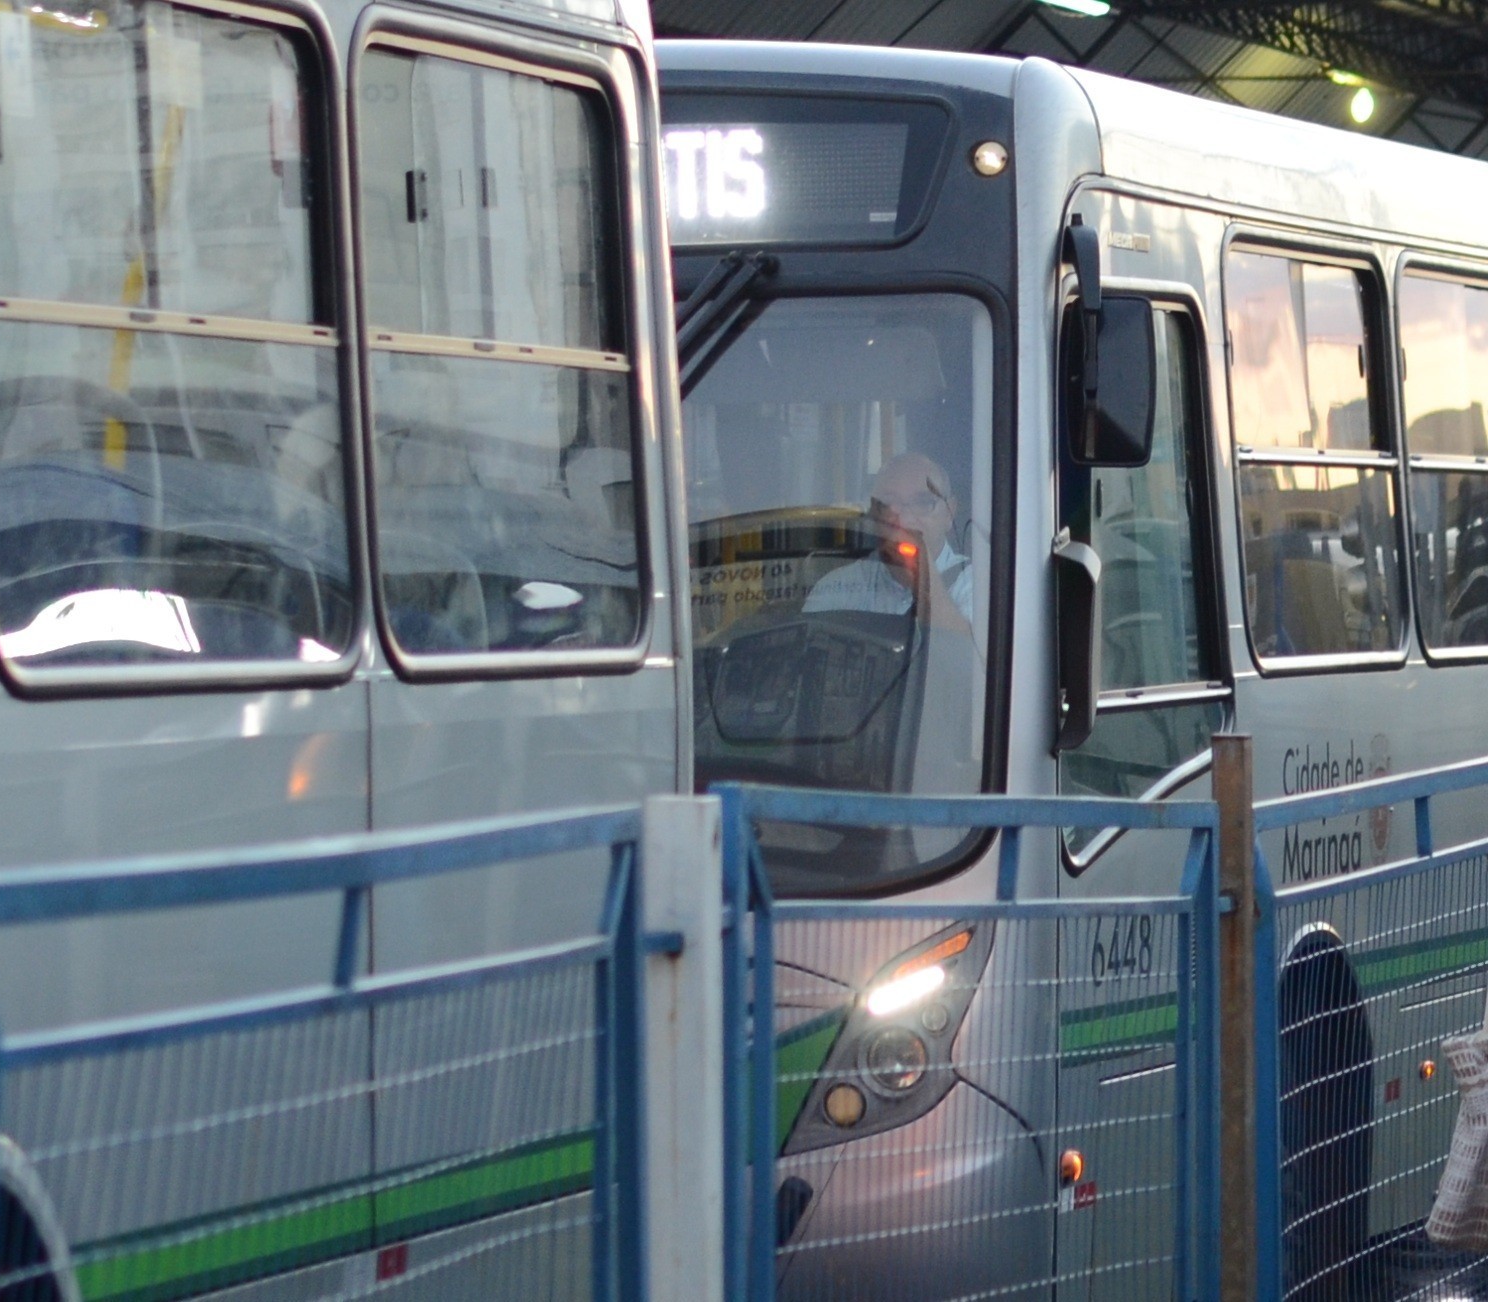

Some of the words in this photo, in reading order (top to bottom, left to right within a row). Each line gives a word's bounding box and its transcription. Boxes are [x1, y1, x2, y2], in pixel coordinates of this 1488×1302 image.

[1282, 741, 1341, 796] Cidade
[1345, 739, 1364, 786] de
[1091, 914, 1152, 988] 6448
